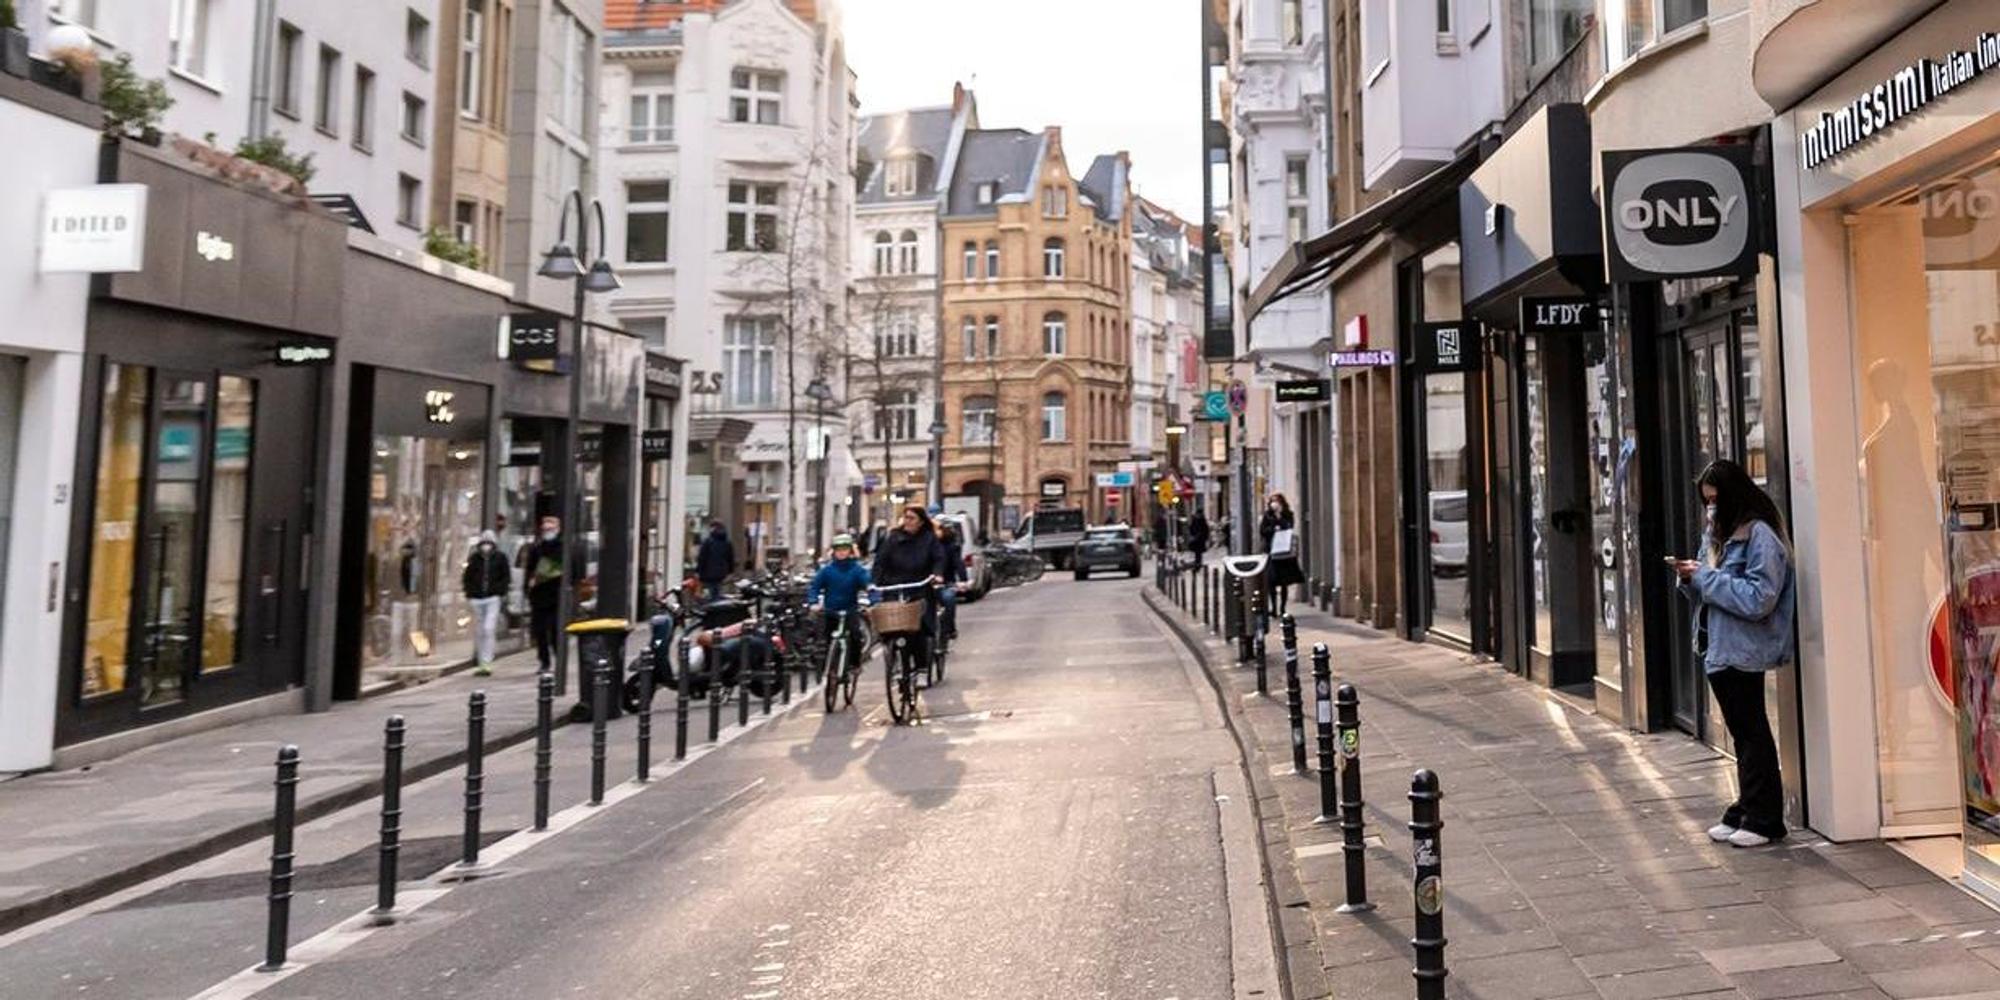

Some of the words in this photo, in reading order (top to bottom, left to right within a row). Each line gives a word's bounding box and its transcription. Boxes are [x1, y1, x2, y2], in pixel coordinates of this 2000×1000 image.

[1931, 50, 1974, 97] Italian
[1620, 195, 1738, 230] ONLY
[1535, 304, 1584, 325] LFDY
[512, 327, 556, 344] COS
